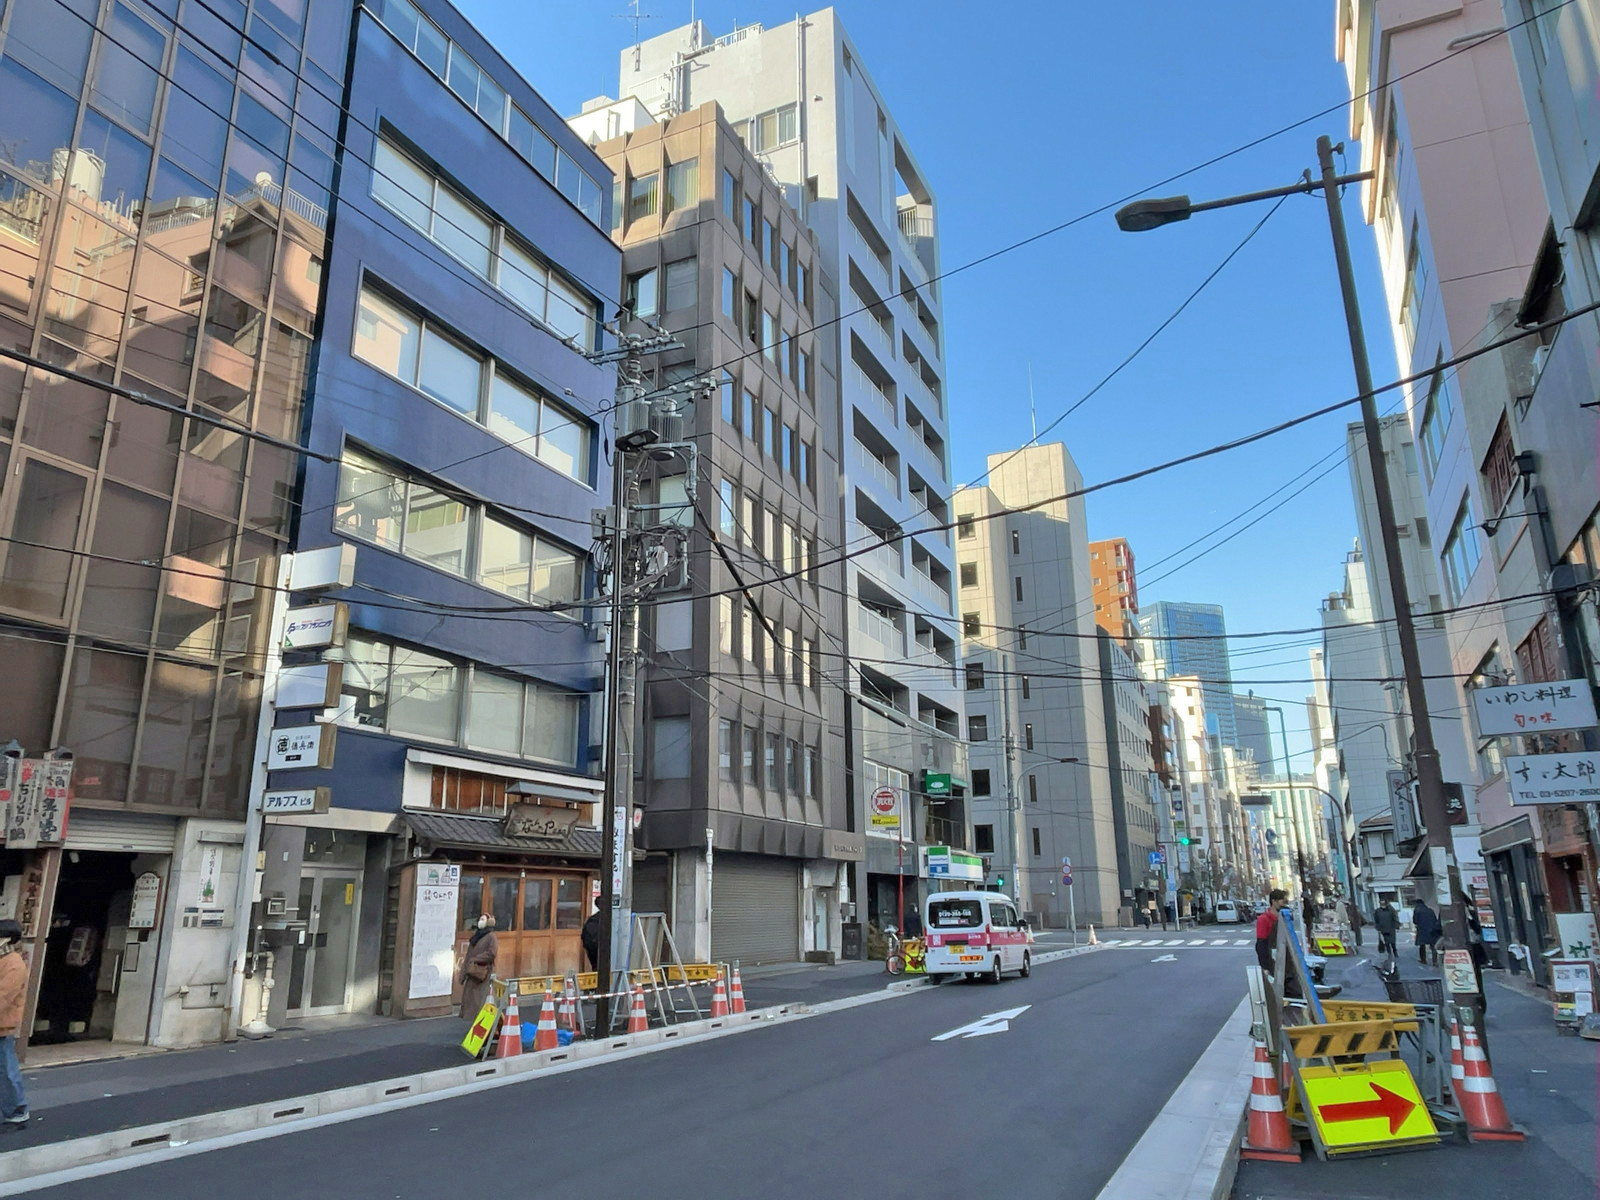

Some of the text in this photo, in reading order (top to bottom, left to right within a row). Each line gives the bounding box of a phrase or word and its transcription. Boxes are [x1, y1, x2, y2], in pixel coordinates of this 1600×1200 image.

[1485, 686, 1576, 707] いわし料理
[1514, 711, 1557, 728] 旬の味
[1519, 791, 1537, 799] TEL
